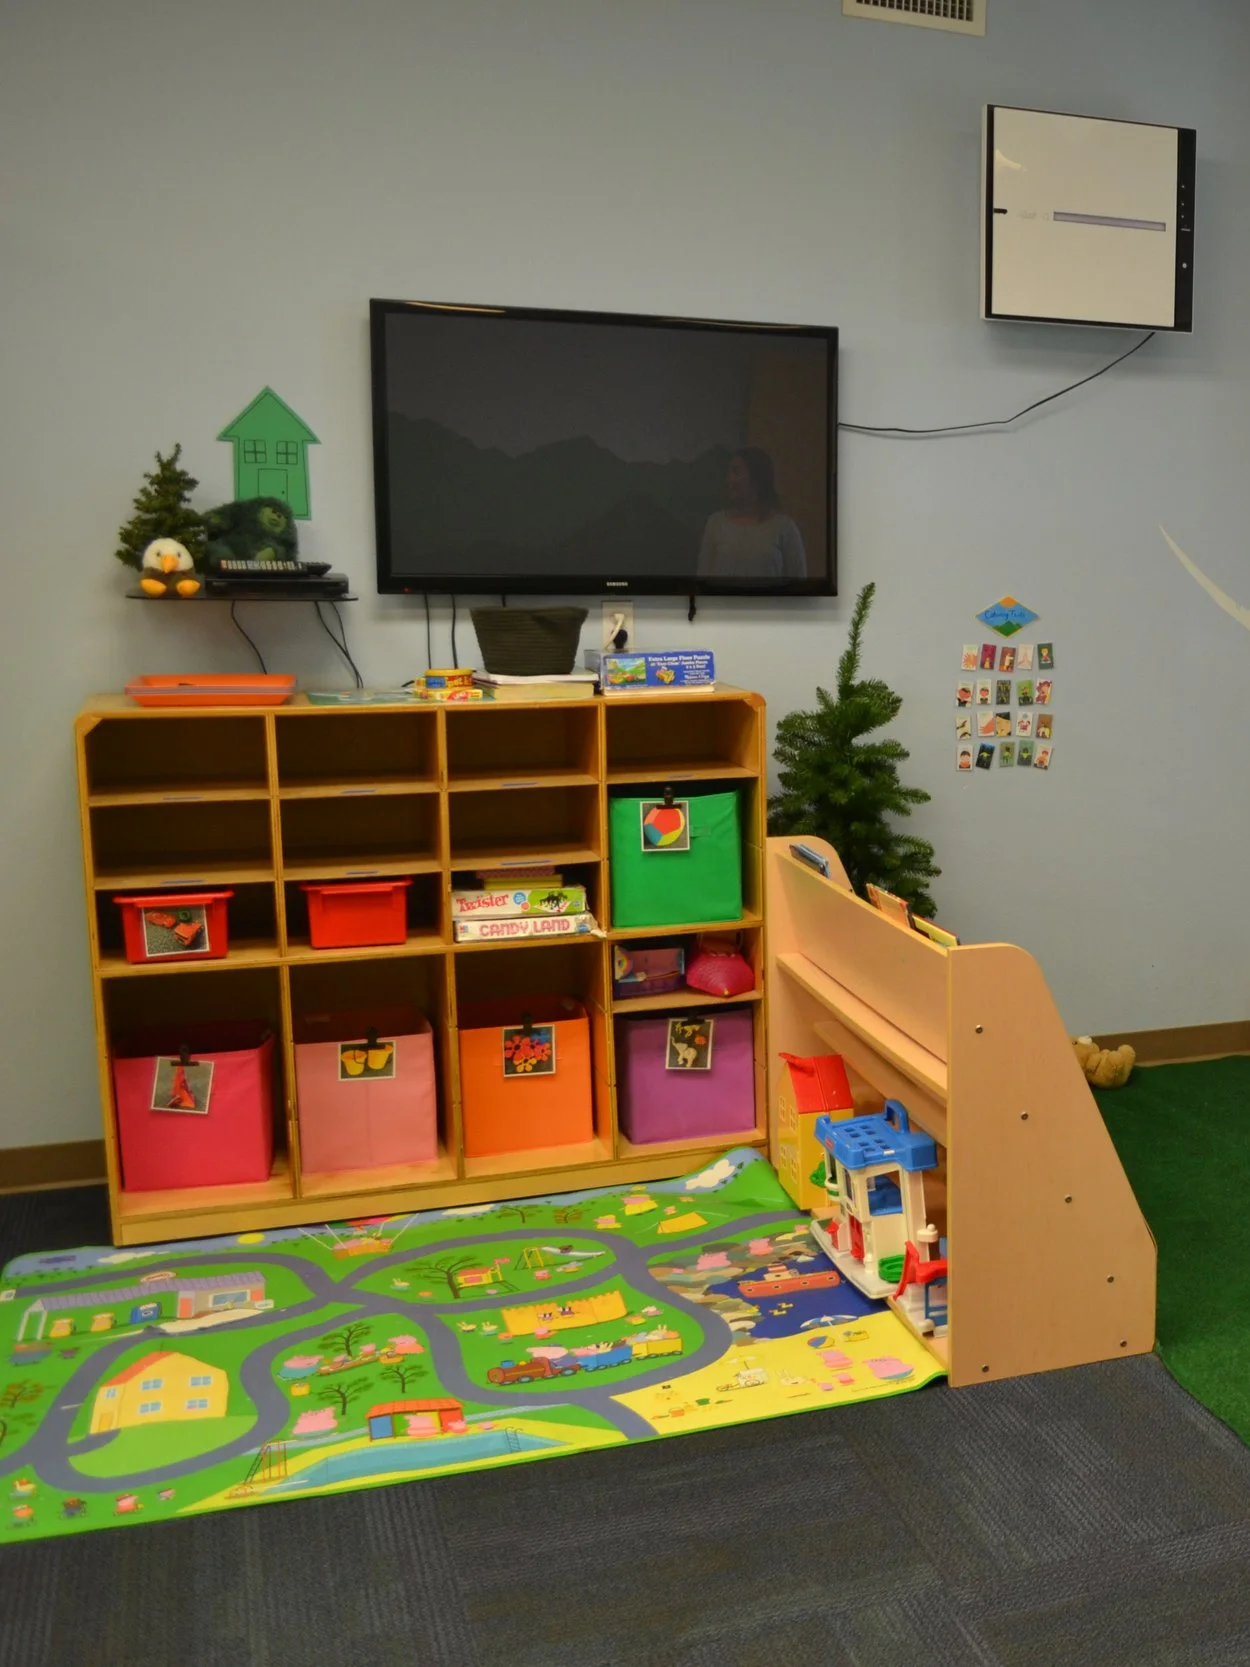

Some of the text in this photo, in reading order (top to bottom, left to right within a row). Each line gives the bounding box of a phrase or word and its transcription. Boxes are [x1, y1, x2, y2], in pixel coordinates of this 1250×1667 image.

[455, 894, 509, 913] Twister
[479, 923, 529, 937] CANDY
[533, 919, 570, 933] LAND
